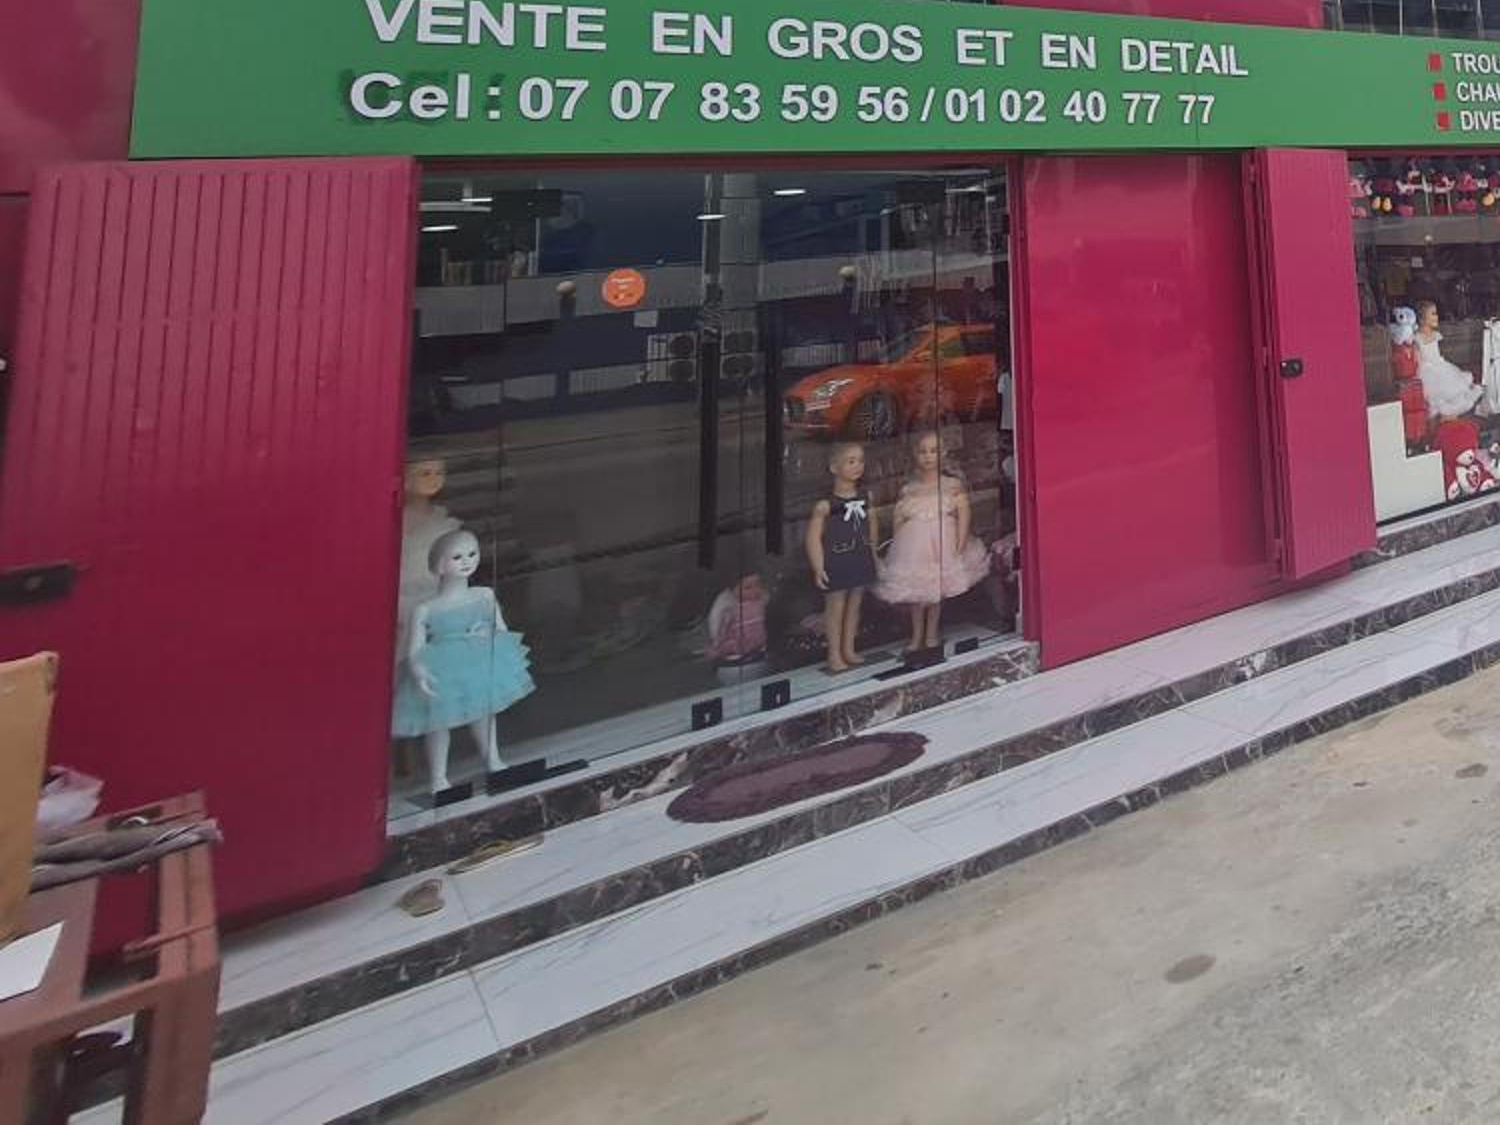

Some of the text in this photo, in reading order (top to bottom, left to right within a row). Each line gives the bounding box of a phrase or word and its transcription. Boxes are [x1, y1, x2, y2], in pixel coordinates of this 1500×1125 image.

[652, 11, 733, 56] EN
[767, 18, 923, 62] GROS
[956, 28, 1014, 66] ET
[1041, 32, 1097, 70] EN
[1121, 38, 1249, 77] DETAIL
[518, 77, 590, 120] 07
[610, 80, 676, 121] 07
[700, 82, 761, 122] 83
[781, 84, 839, 122] 59
[1000, 89, 1047, 123] 02
[1063, 91, 1107, 123] 40
[1122, 93, 1161, 124] 77
[1178, 94, 1215, 124] 77
